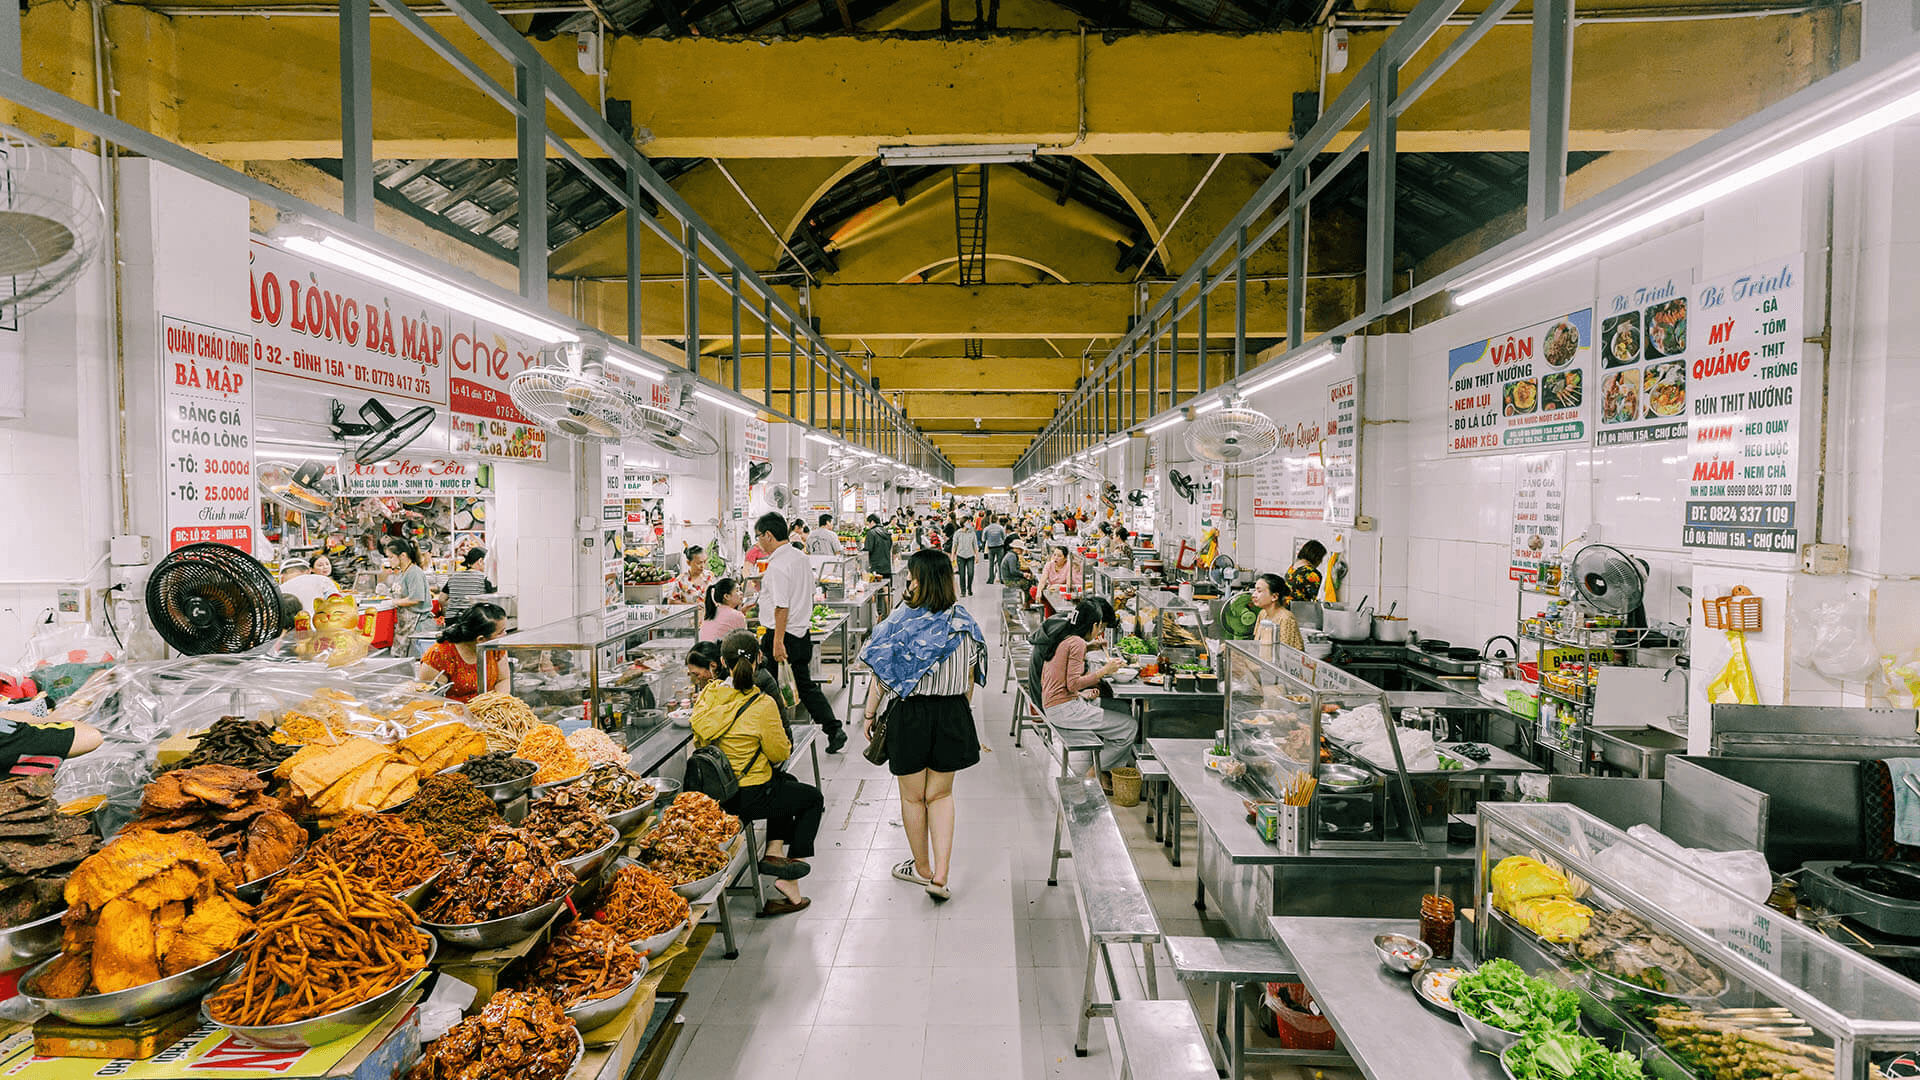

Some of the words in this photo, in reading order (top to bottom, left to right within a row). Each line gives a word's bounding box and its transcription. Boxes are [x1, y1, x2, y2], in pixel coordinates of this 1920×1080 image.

[1763, 296, 1778, 313] GÀ
[289, 271, 360, 347] LÒNG
[365, 297, 397, 357] BÀ
[402, 309, 443, 376] MẬP
[1762, 318, 1787, 336] TÔM
[167, 324, 195, 355] QUÁN
[198, 332, 223, 360] CHÁO
[226, 335, 249, 365] LÒNG
[1491, 336, 1533, 367] VÂN
[1761, 341, 1785, 358] THỊT
[267, 345, 282, 365] 32
[293, 349, 321, 373] ĐÌNH
[324, 358, 345, 378] 15A
[371, 369, 395, 388] 0779
[397, 376, 412, 391] 417
[415, 379, 431, 395] 375
[1692, 347, 1751, 381] QUẢNG
[1761, 361, 1798, 380] TRỨNG
[175, 359, 200, 388] BÀ
[206, 365, 243, 398] MẬP
[1455, 377, 1473, 392] BÚN
[1475, 372, 1494, 388] THỊT
[1496, 363, 1533, 383] NƯỚNG
[461, 385, 470, 398] 41
[1695, 394, 1717, 416] BÚN
[1721, 392, 1745, 415] THỊT
[1748, 385, 1793, 410] NƯỚNG
[1455, 397, 1474, 411] NEM
[1476, 393, 1491, 410] LỤI
[179, 401, 217, 424] BẢNG
[219, 408, 241, 426] GIÁ
[1481, 409, 1499, 426] LỐT
[171, 426, 211, 446] CHÁO
[214, 429, 248, 448] LÒNG
[452, 416, 475, 433] Kem
[490, 420, 507, 437] Chè
[527, 427, 546, 442] Sinh
[1636, 428, 1648, 441] 15A
[1745, 422, 1763, 436] HEO
[1766, 420, 1789, 435] QUAY
[1454, 435, 1478, 450] BÁNH
[1744, 443, 1762, 457] HEO
[1765, 439, 1789, 458] LUỘC
[178, 453, 198, 473] TÔ:
[384, 459, 423, 478] Chợ
[428, 458, 466, 476] Cồn
[1744, 465, 1765, 479] NEM
[1767, 460, 1787, 478] CHẢ
[178, 481, 198, 501] TÔ:
[405, 479, 422, 488] SINH
[1747, 485, 1763, 496] 0824
[1765, 484, 1778, 496] 337
[1779, 484, 1792, 496] 109
[1691, 505, 1708, 521] ĐT:
[1709, 506, 1737, 522] 0824
[1740, 506, 1762, 522] 337
[1765, 507, 1788, 523] 109
[201, 530, 210, 541] 32
[235, 528, 248, 539] 15A
[1684, 527, 1694, 544] LÔ
[1695, 531, 1706, 545] 04
[1707, 528, 1728, 546] ĐÌNH
[1730, 532, 1746, 547] 15A
[1753, 532, 1773, 552] CHỢ
[1774, 529, 1795, 550] CỒN
[1553, 651, 1585, 668] BẢNG
